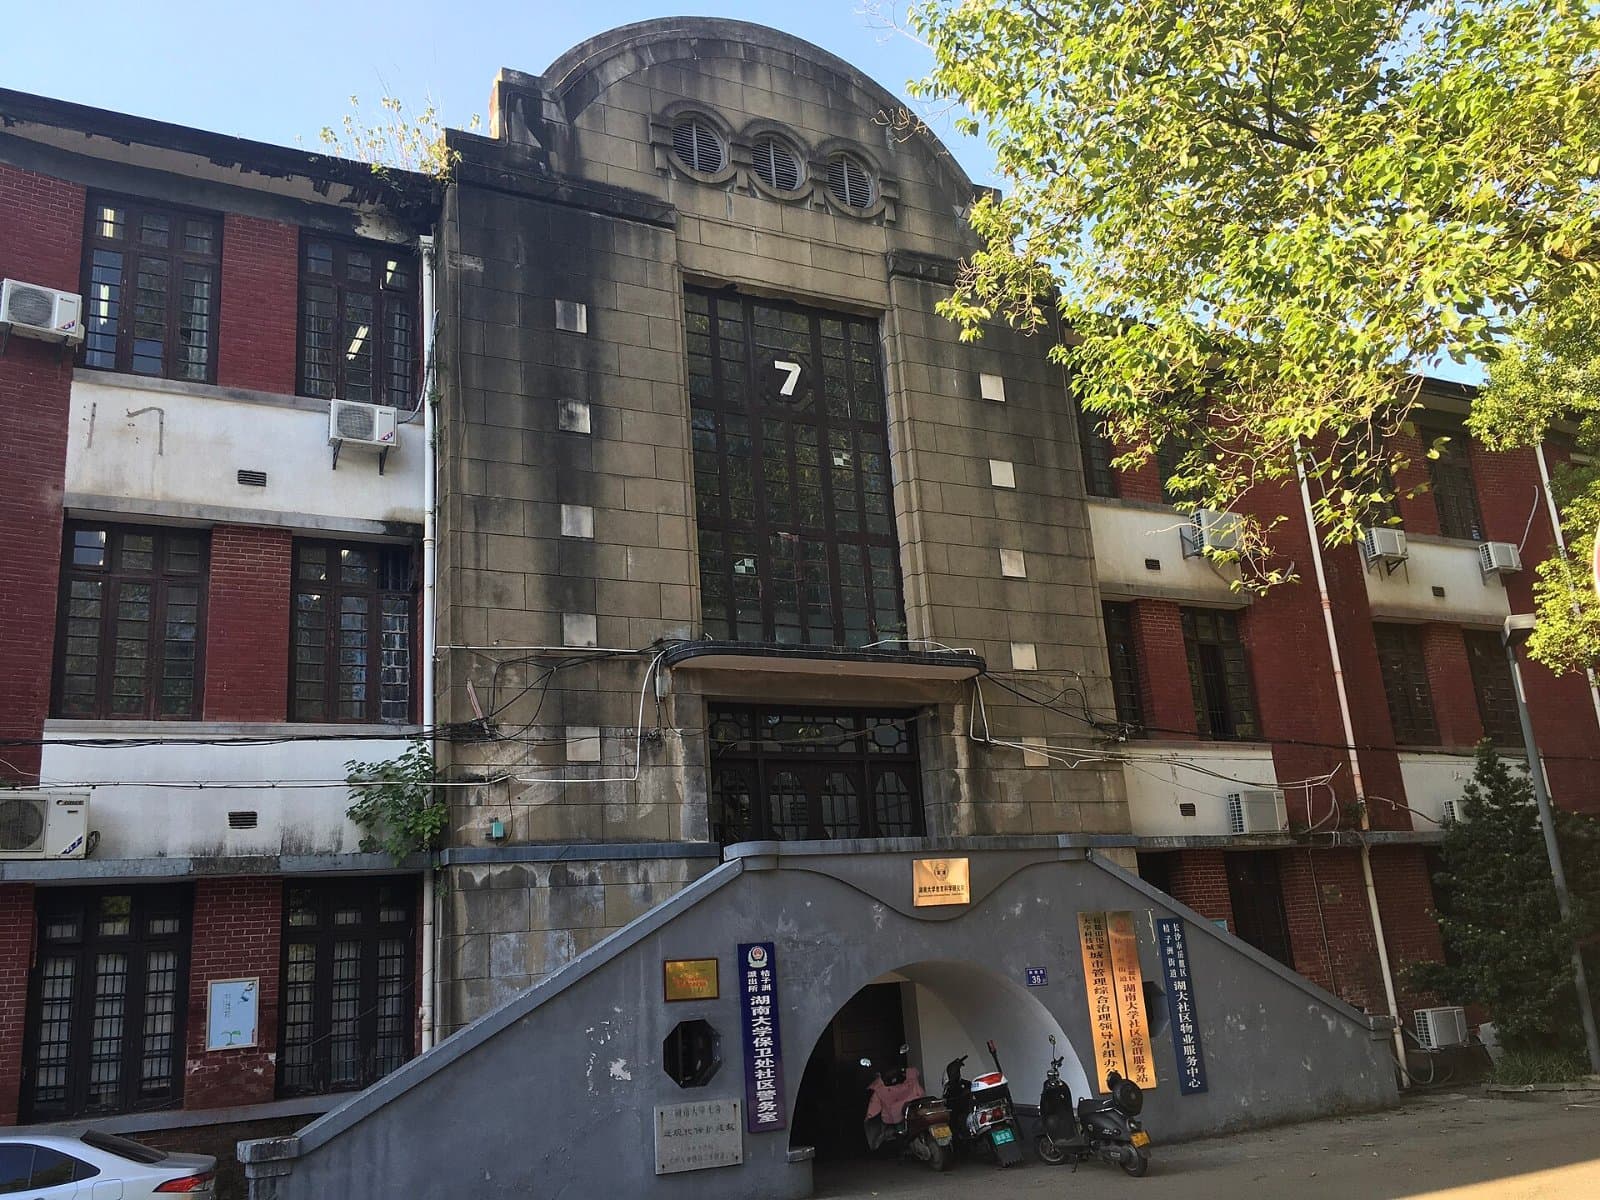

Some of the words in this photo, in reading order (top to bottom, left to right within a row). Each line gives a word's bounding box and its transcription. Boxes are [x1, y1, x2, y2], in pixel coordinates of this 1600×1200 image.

[774, 360, 802, 396] 7
[747, 971, 758, 992] 派出所
[750, 995, 778, 1123] 湖南大学保卫处社区警务室
[1123, 984, 1148, 1083] 湖南大学社区党群服务站
[1173, 980, 1201, 1088] 湖大社区物业服务中心
